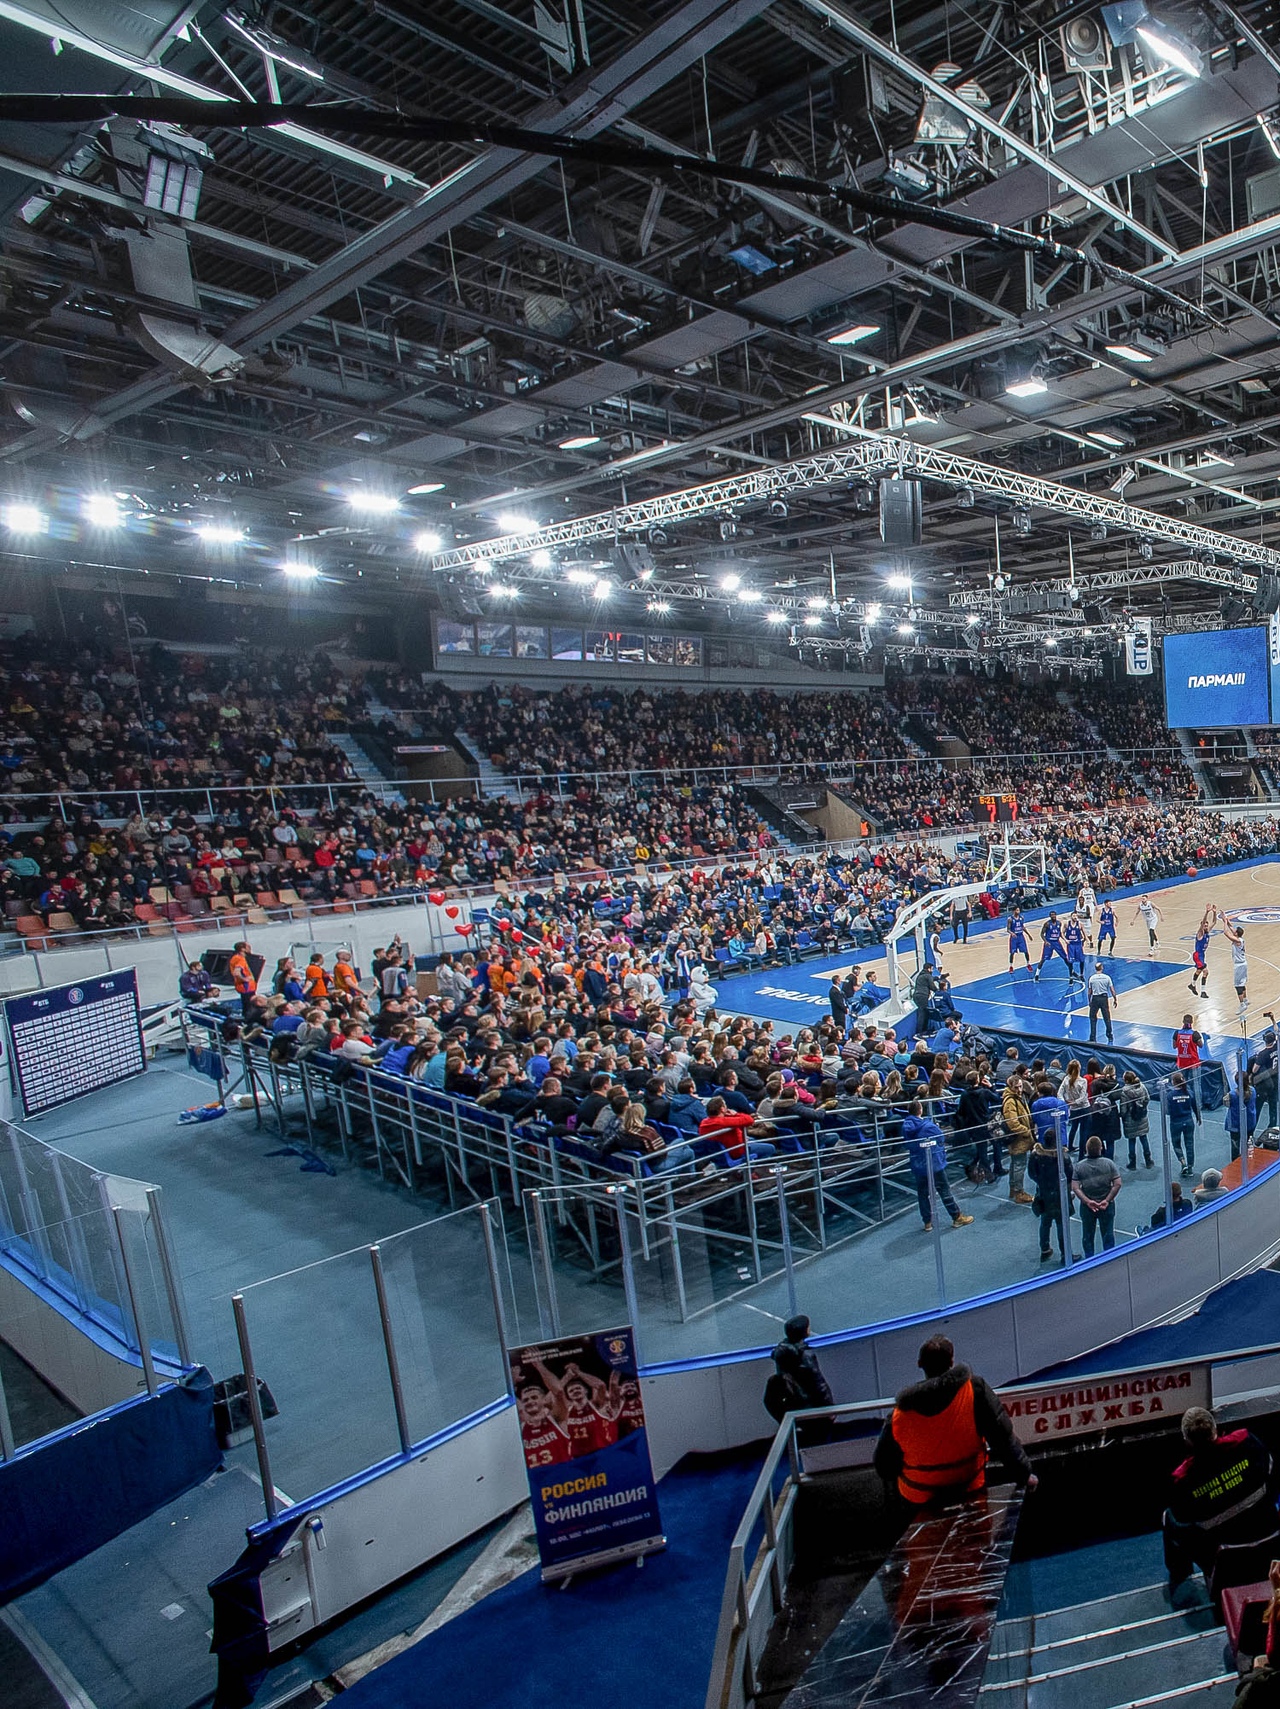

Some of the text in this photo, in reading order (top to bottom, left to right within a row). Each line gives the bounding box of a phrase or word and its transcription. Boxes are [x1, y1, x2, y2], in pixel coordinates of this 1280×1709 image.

[987, 804, 996, 823] 7
[1009, 802, 1017, 821] 7
[1002, 1371, 1191, 1418] МЕДИЦИНСКАЯ
[1034, 1397, 1164, 1434] СЛУЖБА
[527, 1450, 553, 1468] 13
[541, 1472, 607, 1501] РОССИЯ
[544, 1486, 648, 1524] ФИНЛЯНДИЯ
